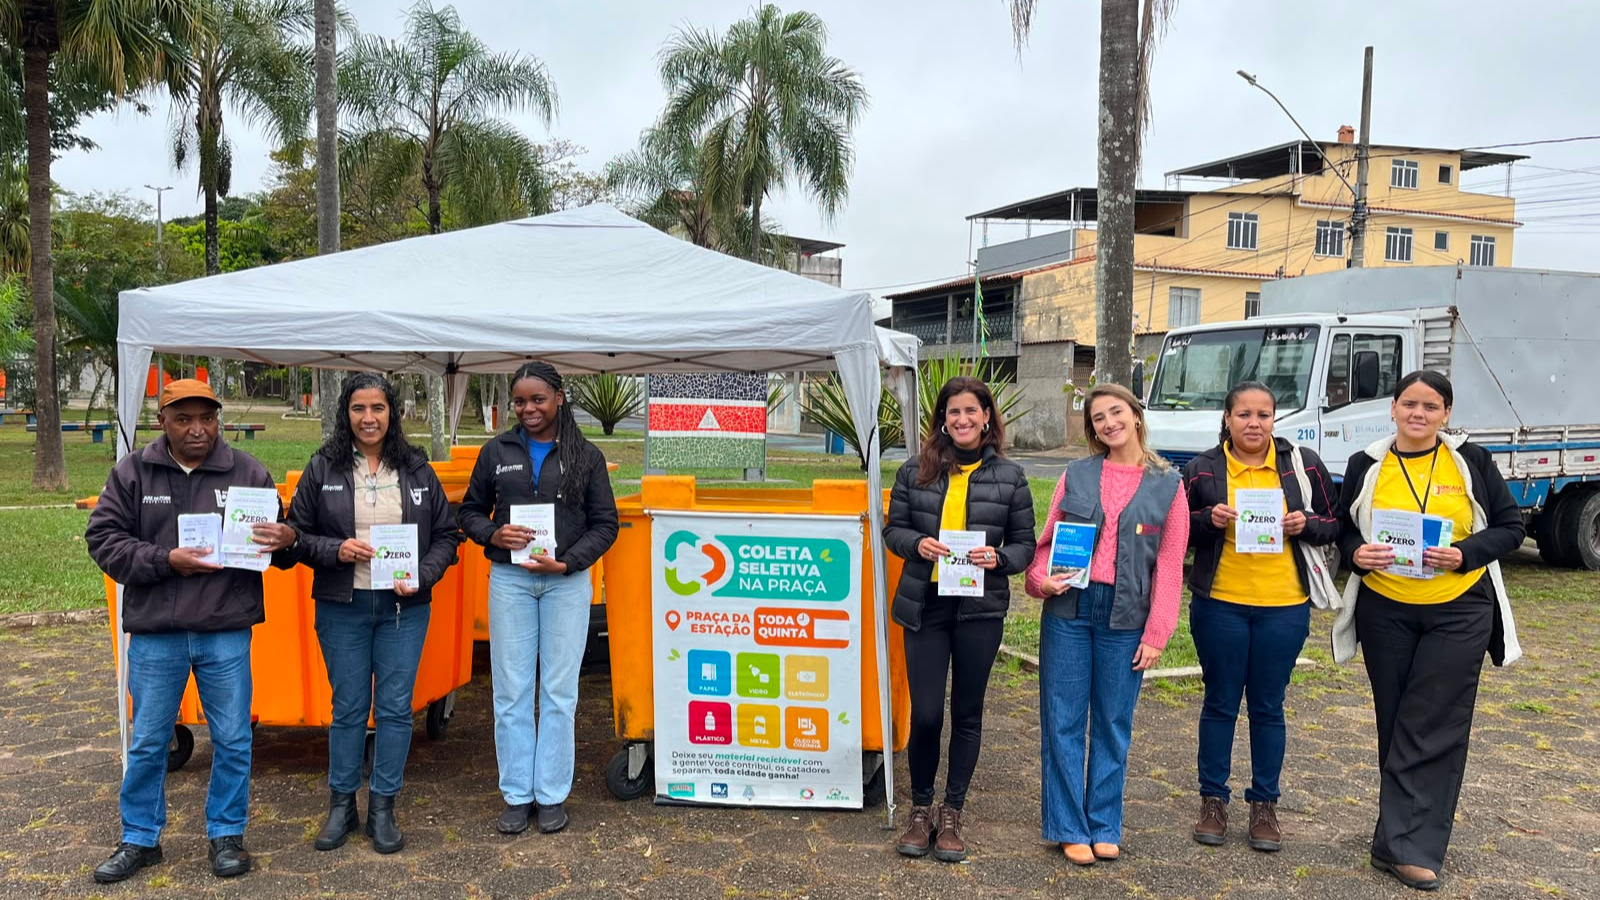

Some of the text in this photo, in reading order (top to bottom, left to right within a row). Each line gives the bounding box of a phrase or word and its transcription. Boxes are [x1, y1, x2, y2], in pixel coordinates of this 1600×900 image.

[1297, 429, 1315, 440] 210
[738, 545, 812, 561] COLETA
[738, 562, 820, 577] SELETIVA
[739, 578, 827, 596] NA PRAÇA
[686, 611, 750, 625] PRAÇA DA
[758, 614, 795, 626] TODA
[690, 623, 750, 637] ESTAÇÃO
[758, 627, 808, 639] QUINTA
[672, 751, 696, 759] Deixe
[715, 753, 755, 761] material
[756, 756, 801, 765] reciclável
[679, 760, 707, 768] gente!
[786, 766, 831, 774] catadores
[736, 769, 767, 778] cidade
[768, 772, 800, 780] ganha!
